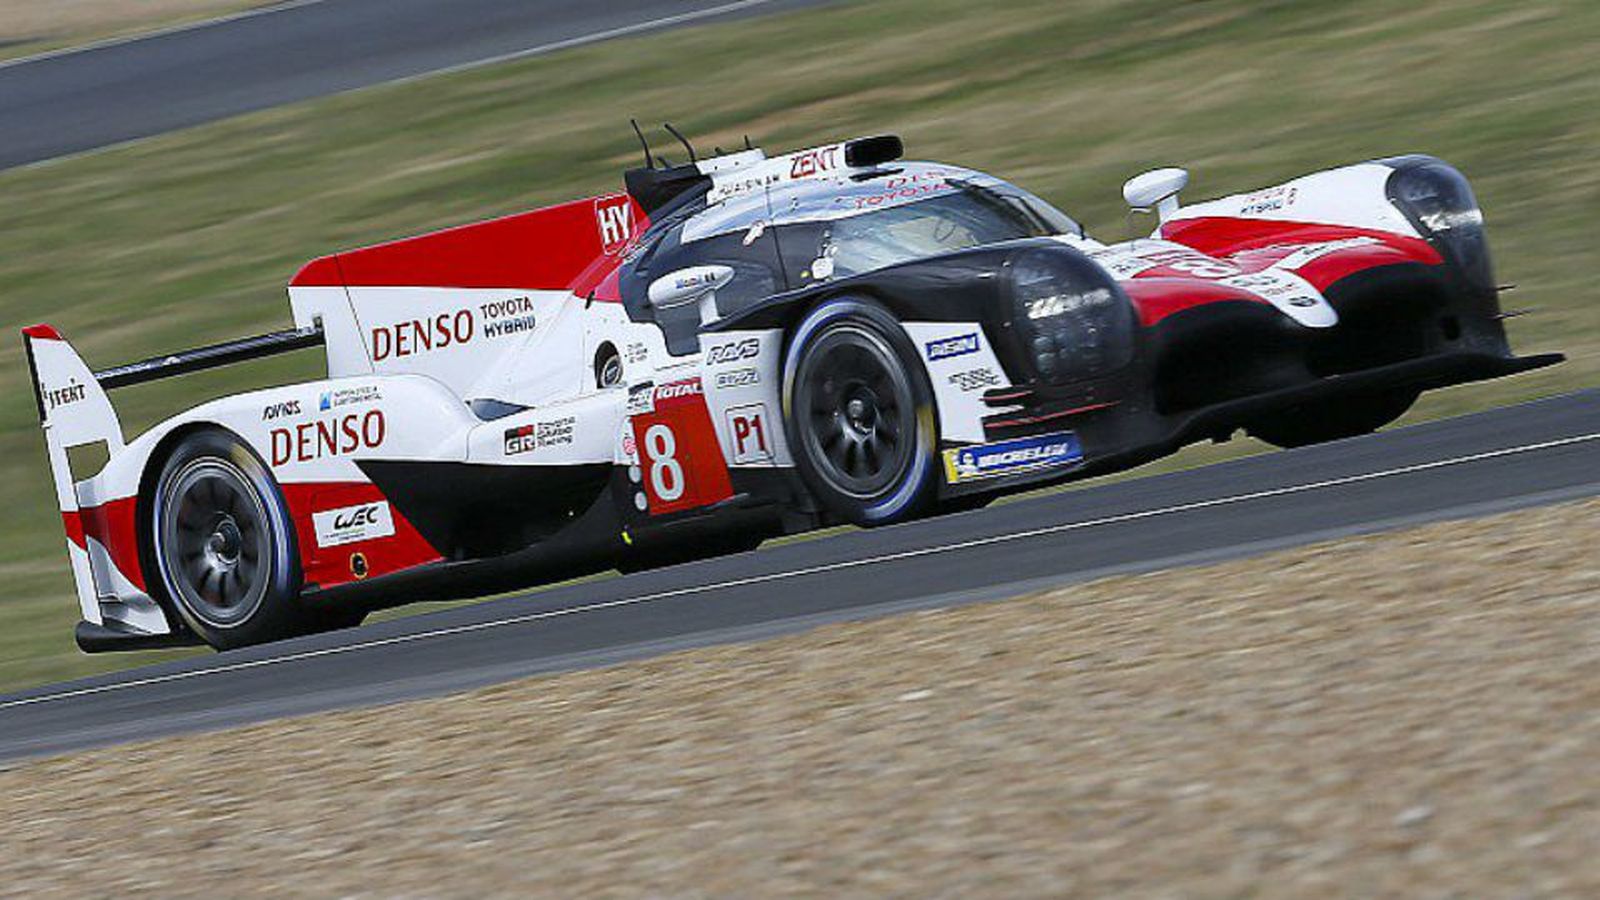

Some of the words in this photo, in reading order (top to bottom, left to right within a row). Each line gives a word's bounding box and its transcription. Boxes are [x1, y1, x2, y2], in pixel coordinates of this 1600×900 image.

[790, 146, 839, 179] ZENT
[597, 202, 630, 245] HY
[480, 296, 534, 320] TOYOTA
[371, 308, 474, 361] DENSO
[656, 382, 703, 400] TOTAL
[269, 407, 386, 467] DENSO
[733, 414, 768, 455] P1
[644, 423, 685, 501] 8
[333, 505, 379, 530] WEC
